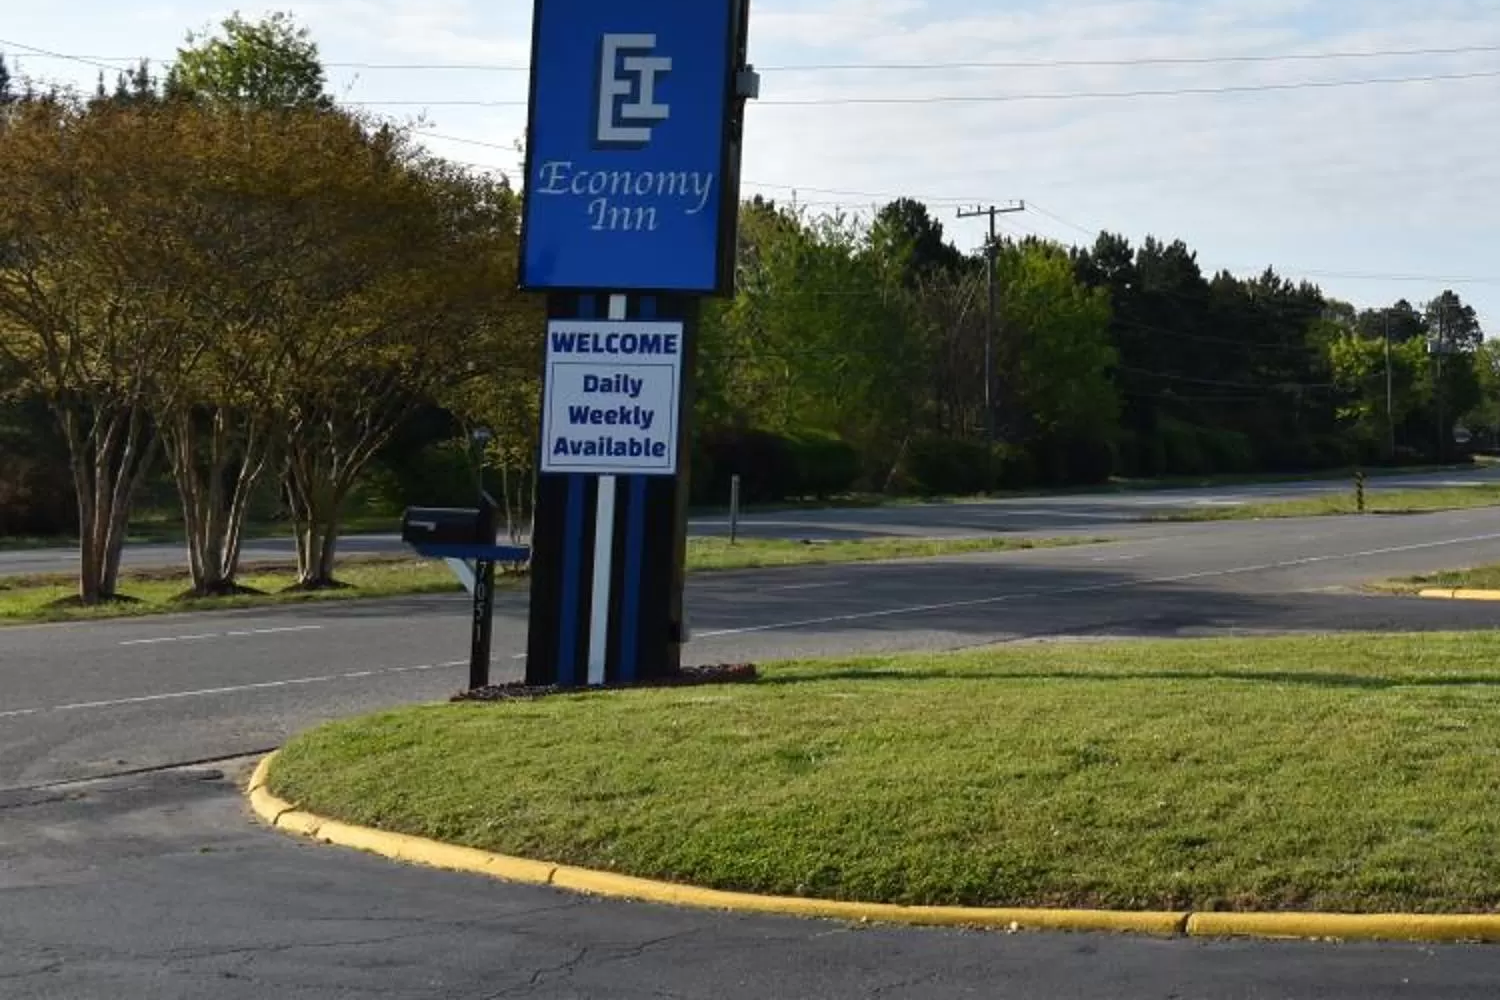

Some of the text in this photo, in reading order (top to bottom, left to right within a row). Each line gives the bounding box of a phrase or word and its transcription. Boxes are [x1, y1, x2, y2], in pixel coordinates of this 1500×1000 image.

[537, 161, 713, 214] Economy
[588, 198, 657, 231] Inn
[552, 332, 678, 354] WELCOME
[583, 374, 643, 398] Daily
[569, 405, 654, 429] Weekly
[553, 436, 666, 457] Available
